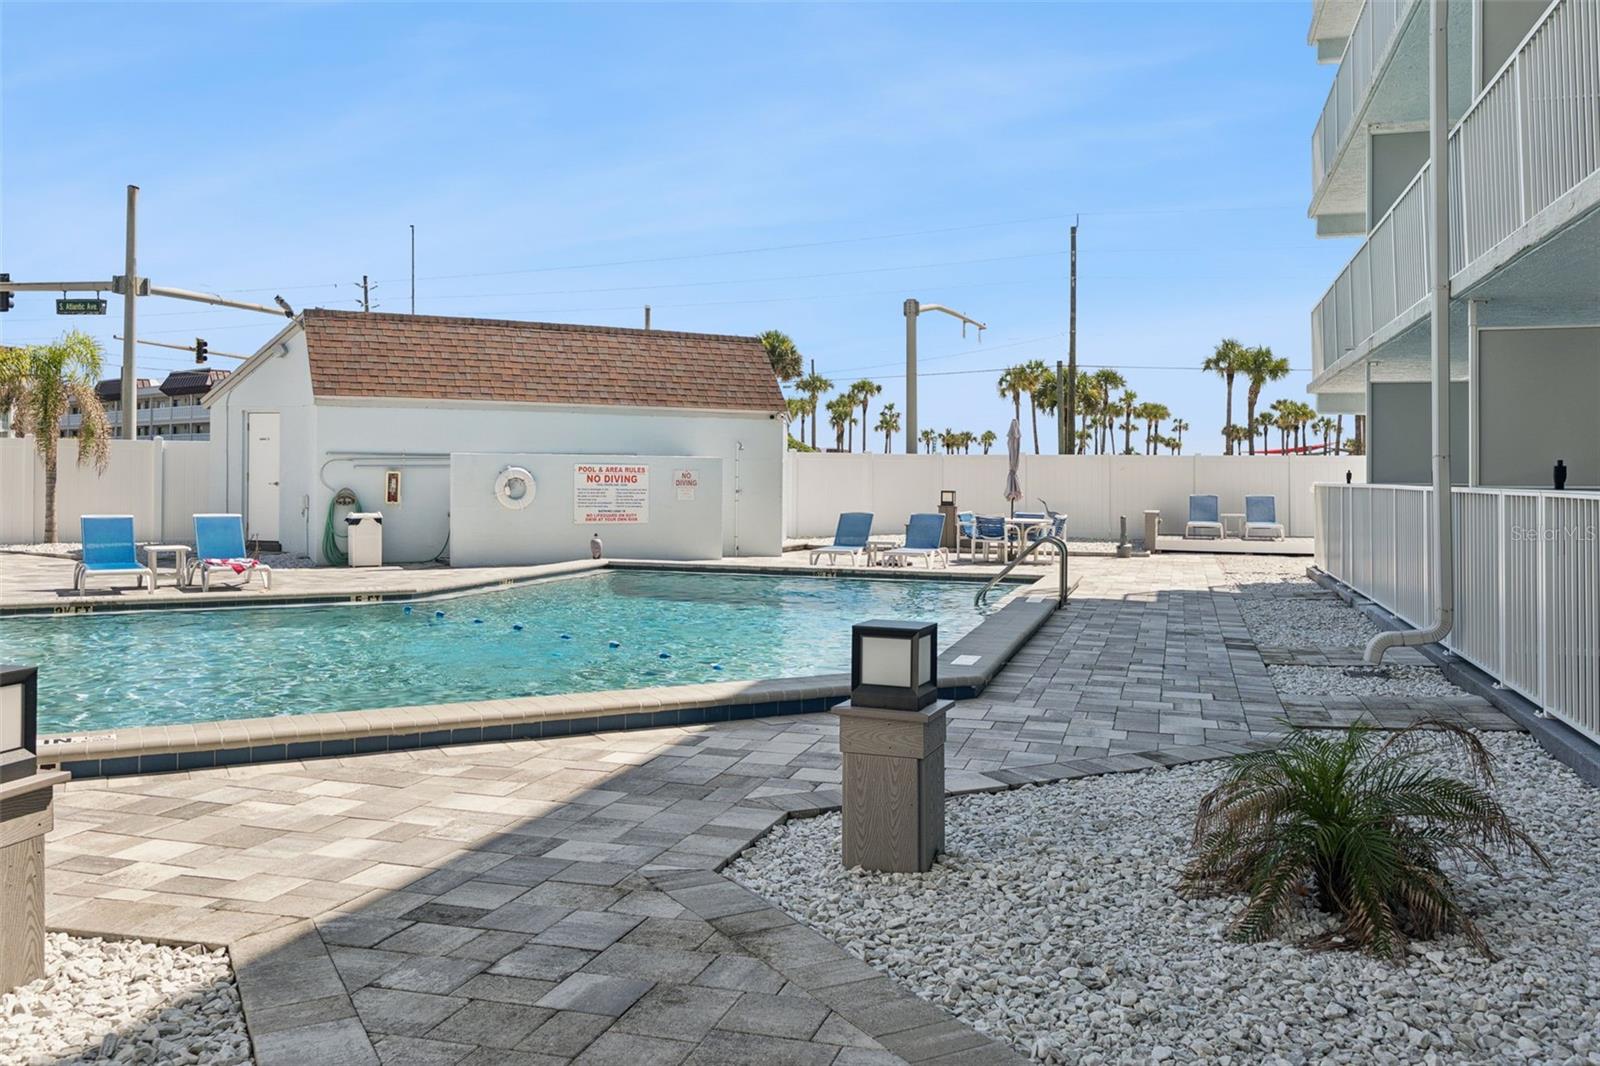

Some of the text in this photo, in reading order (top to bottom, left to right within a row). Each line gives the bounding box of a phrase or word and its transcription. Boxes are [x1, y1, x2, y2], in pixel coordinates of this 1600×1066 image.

[65, 302, 85, 310] Atlantic
[586, 474, 638, 483] NO DIVING
